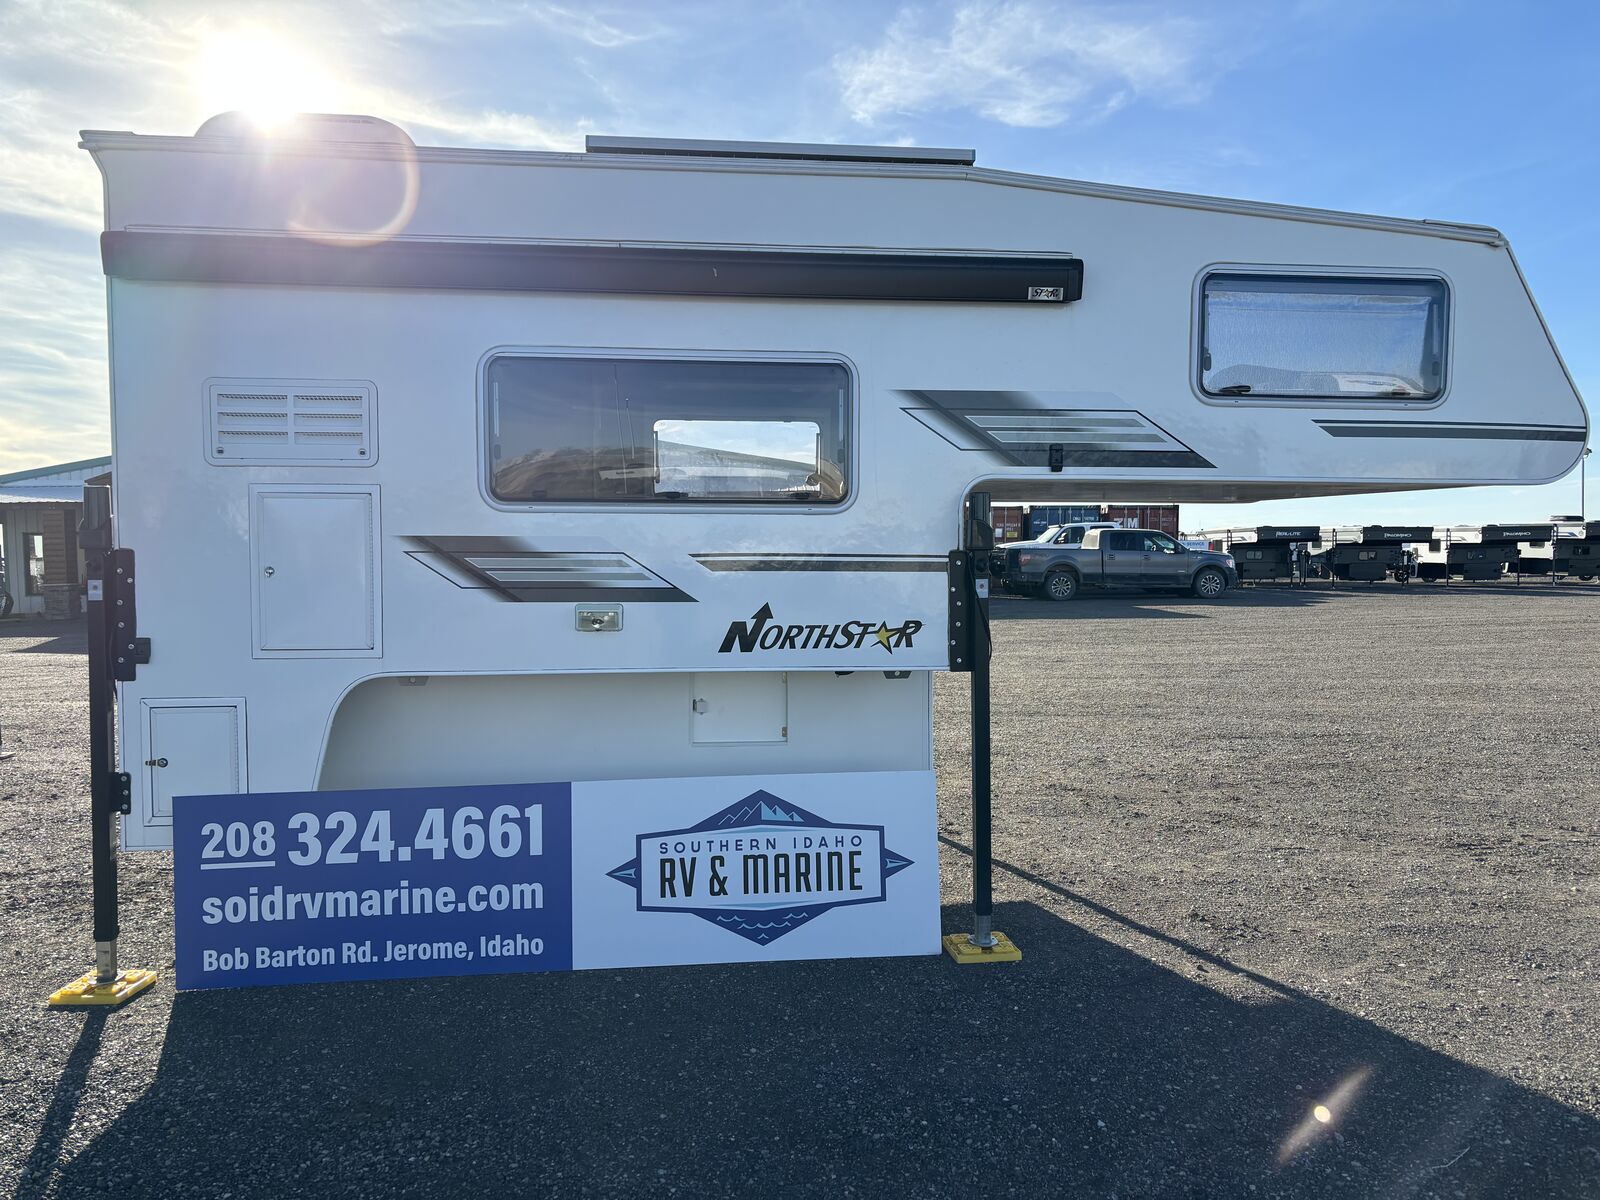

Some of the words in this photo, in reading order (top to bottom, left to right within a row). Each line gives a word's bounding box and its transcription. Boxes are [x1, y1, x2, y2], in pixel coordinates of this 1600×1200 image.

[1113, 517, 1139, 529] ZIM
[200, 820, 276, 859] 208
[287, 803, 544, 867] 324.4661
[659, 837, 777, 854] SOUTHERN
[793, 835, 863, 849] IDAHO
[659, 856, 697, 898] RV
[709, 855, 729, 896] &
[742, 850, 863, 894] MARINE
[201, 880, 545, 925] soidrvmarine.com
[202, 947, 249, 972] Bob
[255, 941, 335, 969] Barton
[342, 938, 379, 964] Rd.
[383, 937, 475, 962] Jerome,
[479, 933, 545, 958] Idaho
